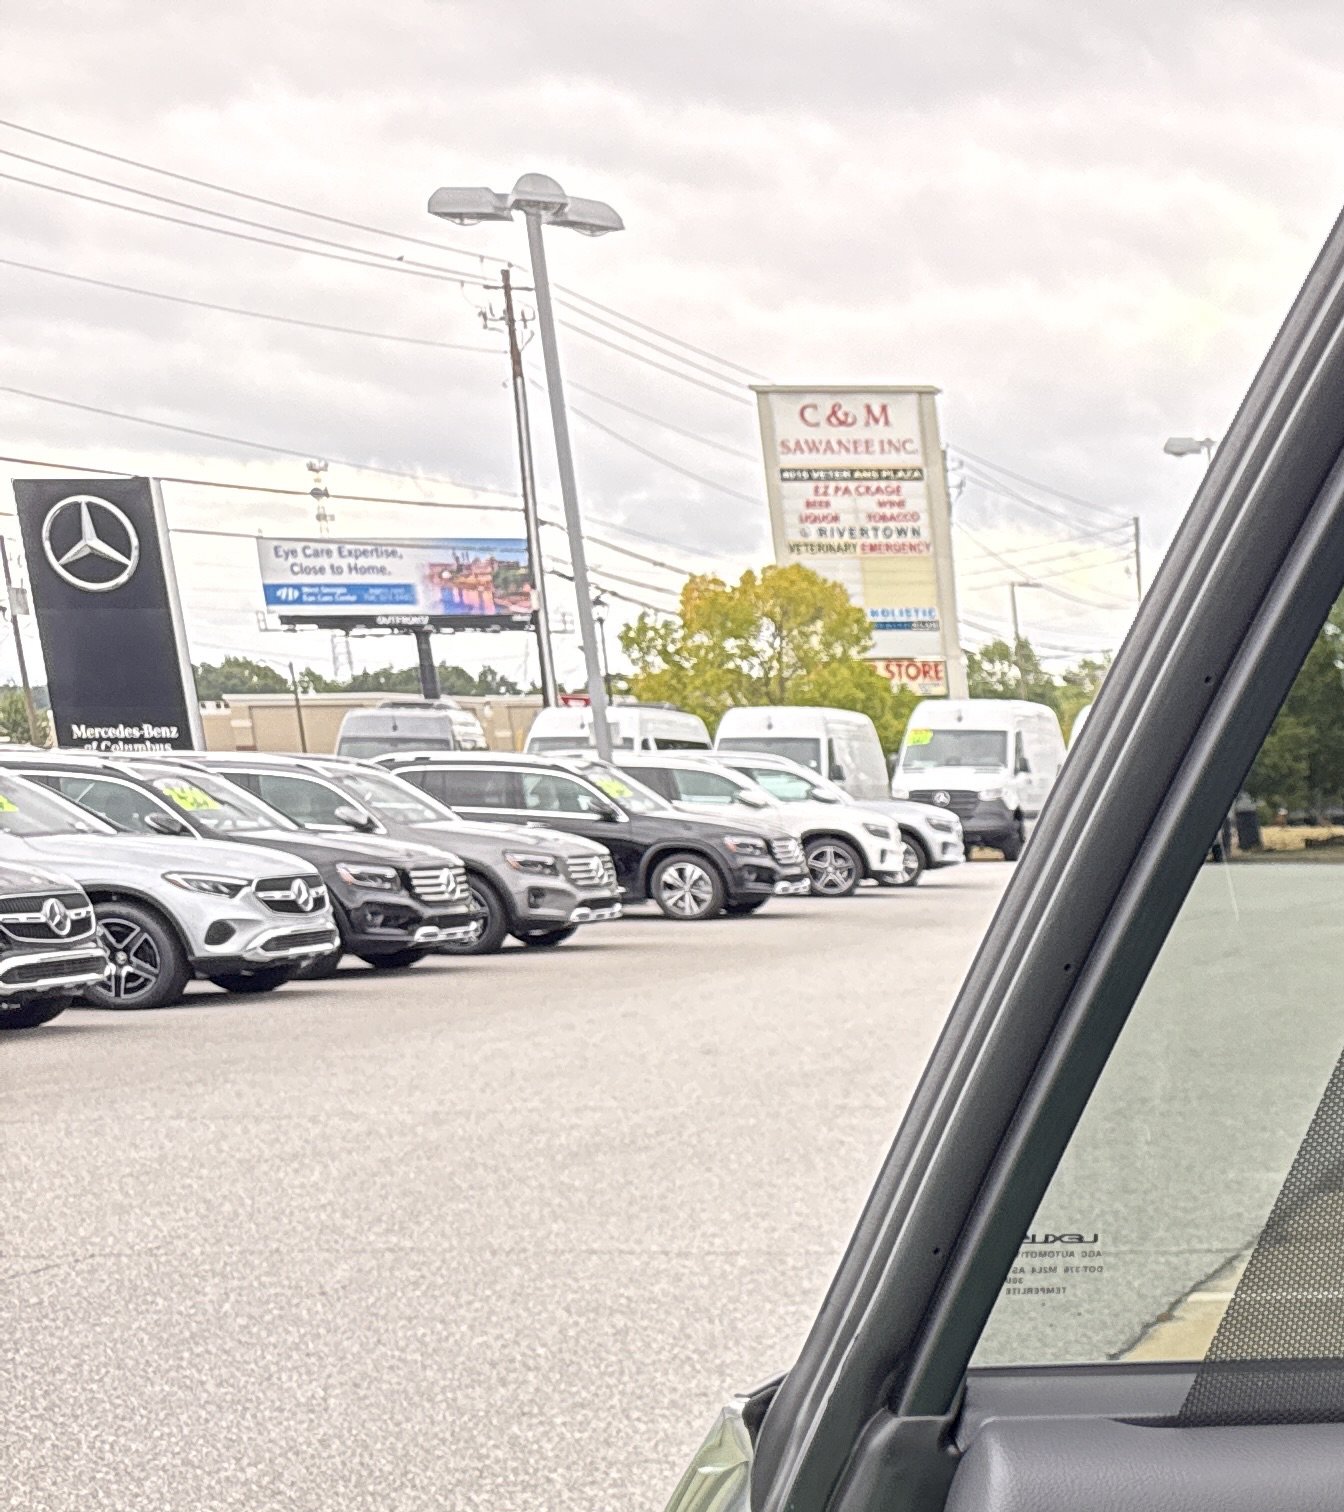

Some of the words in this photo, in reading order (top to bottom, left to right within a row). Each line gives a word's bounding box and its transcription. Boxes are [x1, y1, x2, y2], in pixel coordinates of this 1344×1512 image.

[798, 403, 821, 428] C
[826, 401, 858, 428] &
[863, 402, 891, 427] M
[779, 438, 877, 455] SAWANEE
[813, 484, 830, 497] EZ
[833, 484, 904, 497] PACKAGE
[865, 511, 921, 523] TOBACCO
[817, 526, 922, 539] RIVERTOWN
[273, 544, 299, 561] Eye
[301, 545, 333, 559] Care
[788, 542, 858, 555] VETERINARY
[859, 541, 932, 555] EMERGENCY
[289, 562, 327, 576] Close
[329, 563, 344, 576] to
[347, 563, 392, 576] Home.
[885, 662, 944, 681] STORE
[71, 723, 180, 739] Mercedes-Benz
[100, 740, 173, 752] Columbus
